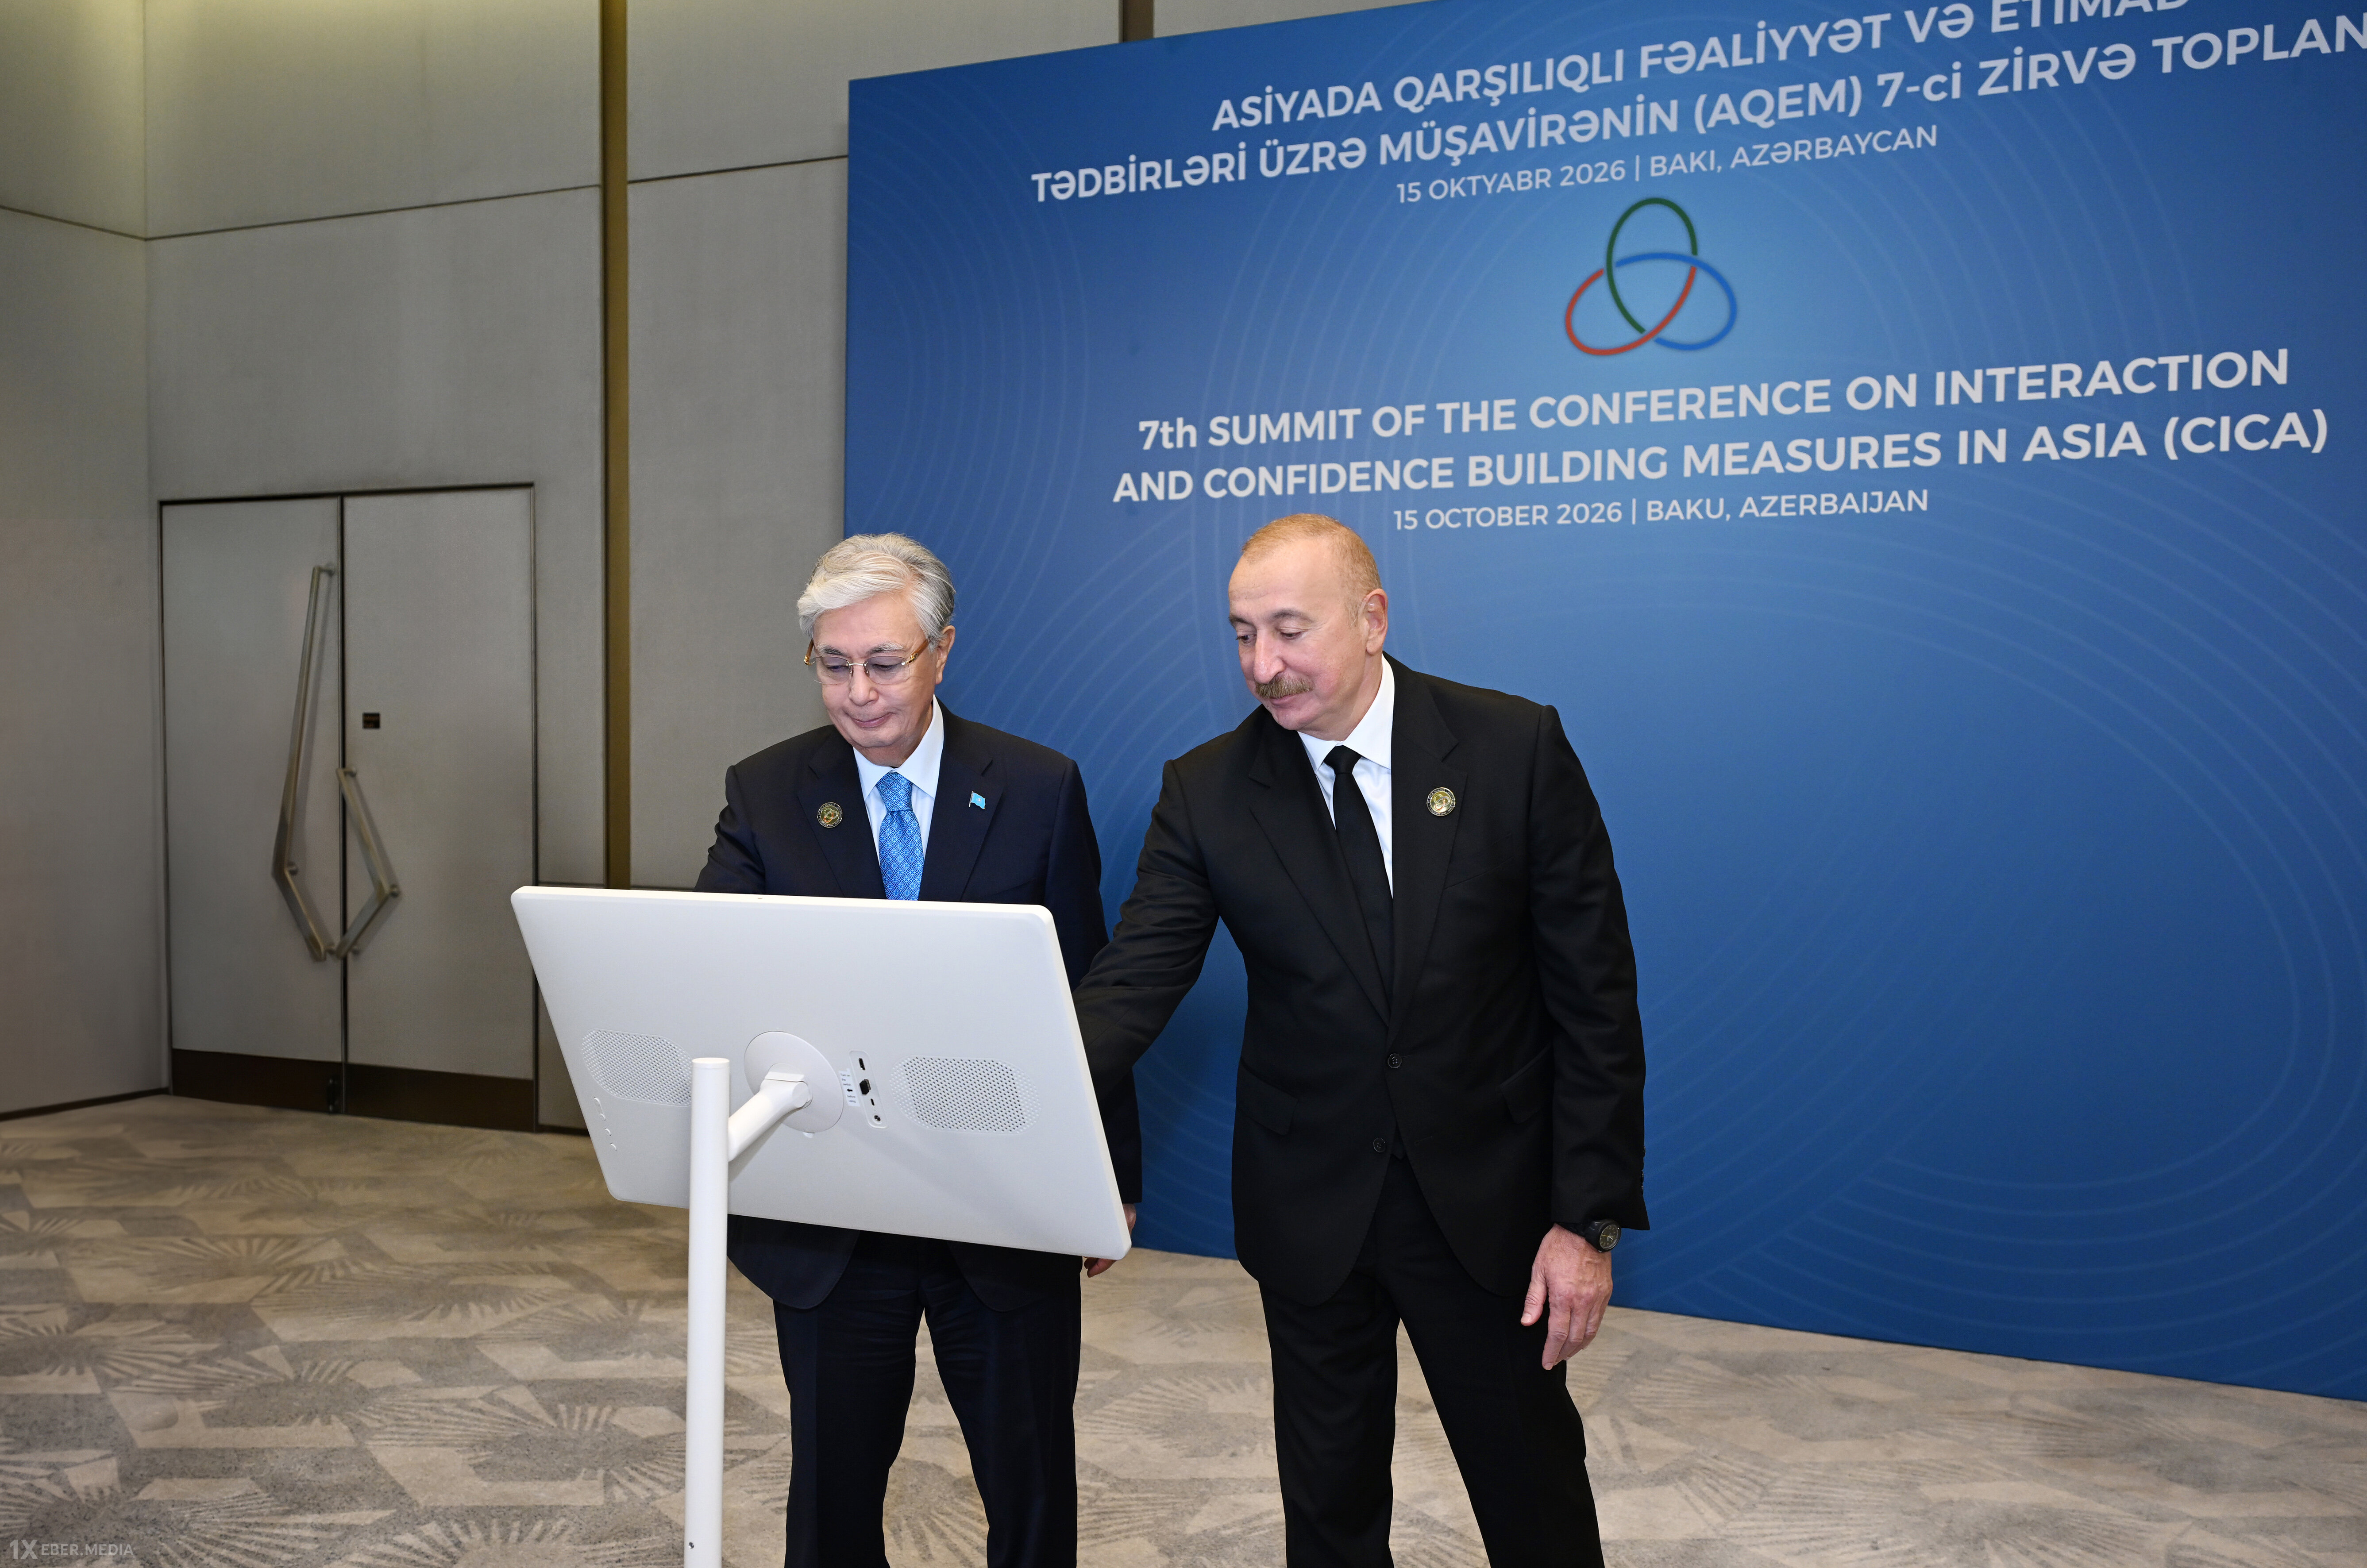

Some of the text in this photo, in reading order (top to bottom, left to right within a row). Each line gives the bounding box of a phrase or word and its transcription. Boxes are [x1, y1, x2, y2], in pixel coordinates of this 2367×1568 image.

[1211, 81, 1383, 131] ASİYADA
[1393, 49, 1624, 114] QARŞILIQLI
[1640, 12, 1892, 79] FƏALİYYƏT
[1904, 3, 1974, 43] VƏ
[1031, 142, 1246, 202] TƏDBİRLƏRİ
[1259, 137, 1367, 178] ÜZRƏ
[1380, 93, 1678, 166] MÜŞAVİRƏNİN
[1694, 75, 1862, 135] (AQEM)
[1877, 61, 1962, 108] 7-ci
[1978, 43, 2136, 96] ZİRVƏ
[1396, 181, 1422, 204] 15
[1429, 168, 1552, 200] OKTYABR
[1560, 159, 1626, 186] 2026
[1650, 150, 1722, 177] BAKI,
[1730, 124, 1937, 169] AZƏRBAYCAN
[1138, 348, 2288, 451] 7th SUMMIT OF THE CONFERENCE ON INTERACTION
[1112, 408, 2328, 503] AND CONFIDENCE BUILDING MEASURES IN ASIA (CICA)
[1393, 509, 1418, 530] 15
[1425, 505, 1549, 529] OCTOBER
[1556, 501, 1623, 524] 2026
[1647, 497, 1731, 521] BAKU,
[1739, 489, 1928, 518] AZERBAIJAN
